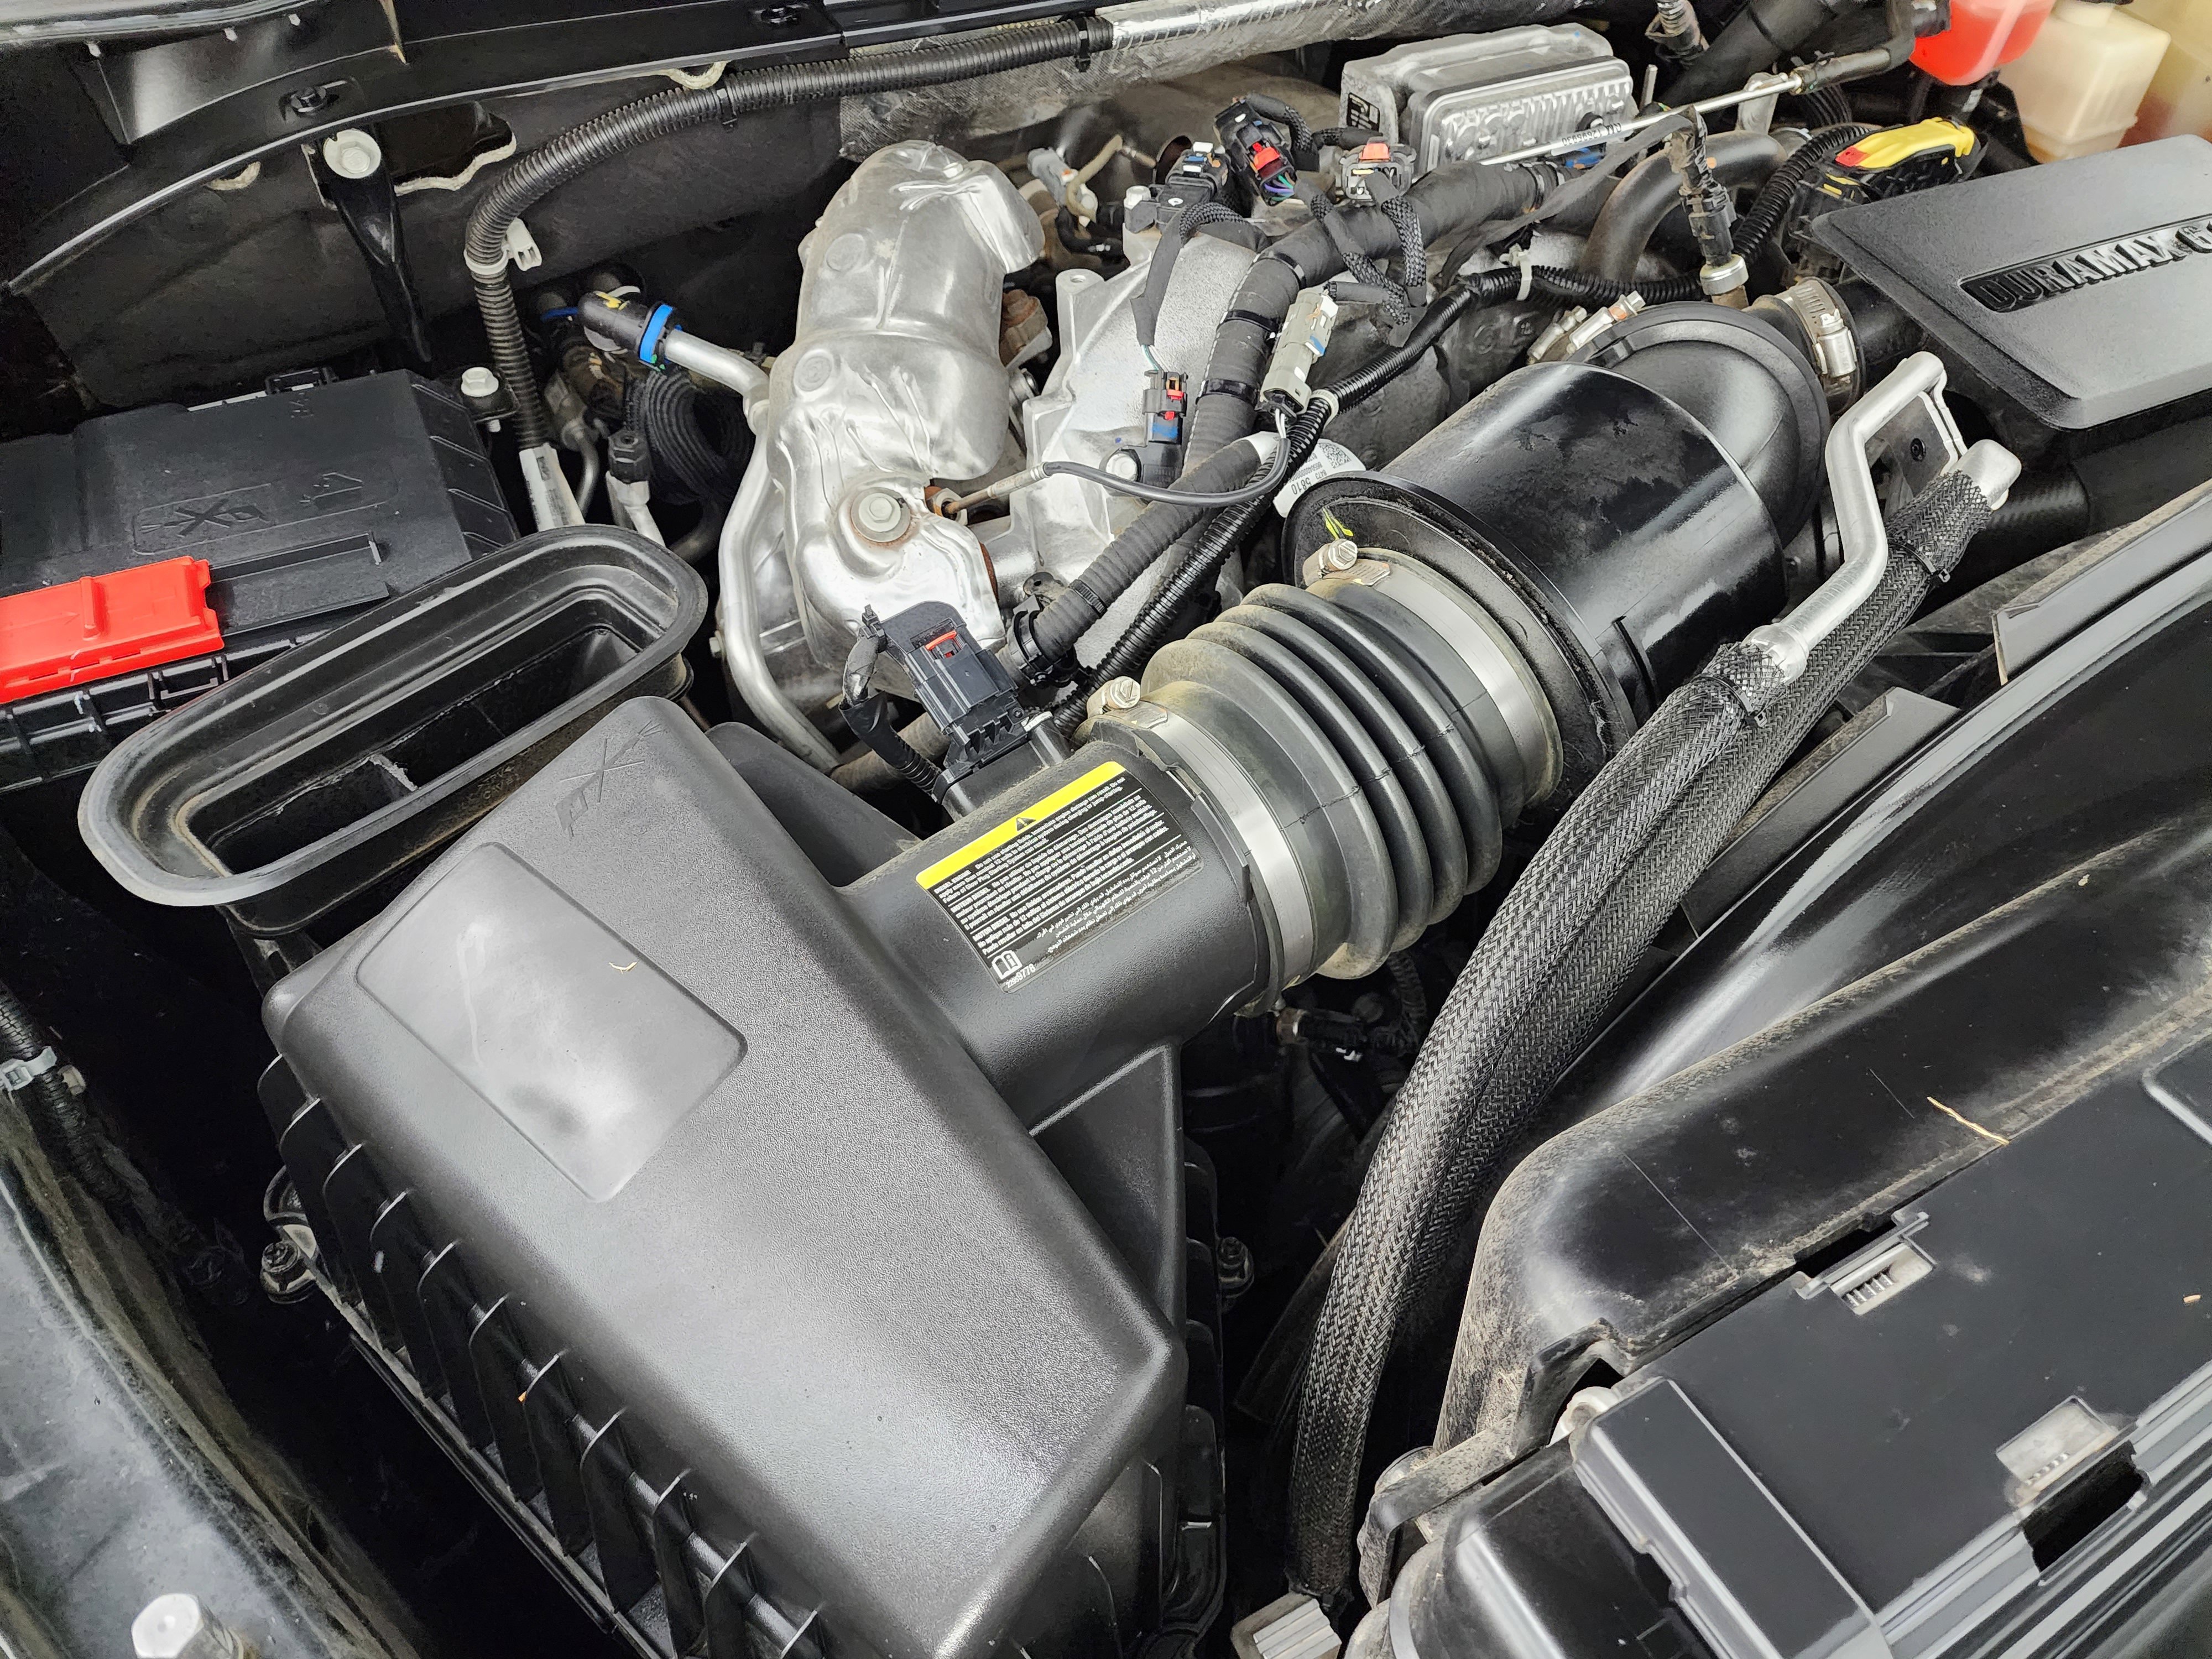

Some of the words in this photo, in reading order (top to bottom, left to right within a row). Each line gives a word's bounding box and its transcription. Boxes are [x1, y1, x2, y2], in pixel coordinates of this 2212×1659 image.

[1968, 232, 2187, 311] DURAMAX
[2175, 222, 2212, 253] 6
[1291, 477, 1312, 495] 5810
[977, 873, 990, 882] Plug
[1019, 914, 1027, 922] 12
[972, 926, 993, 942] MOTOR
